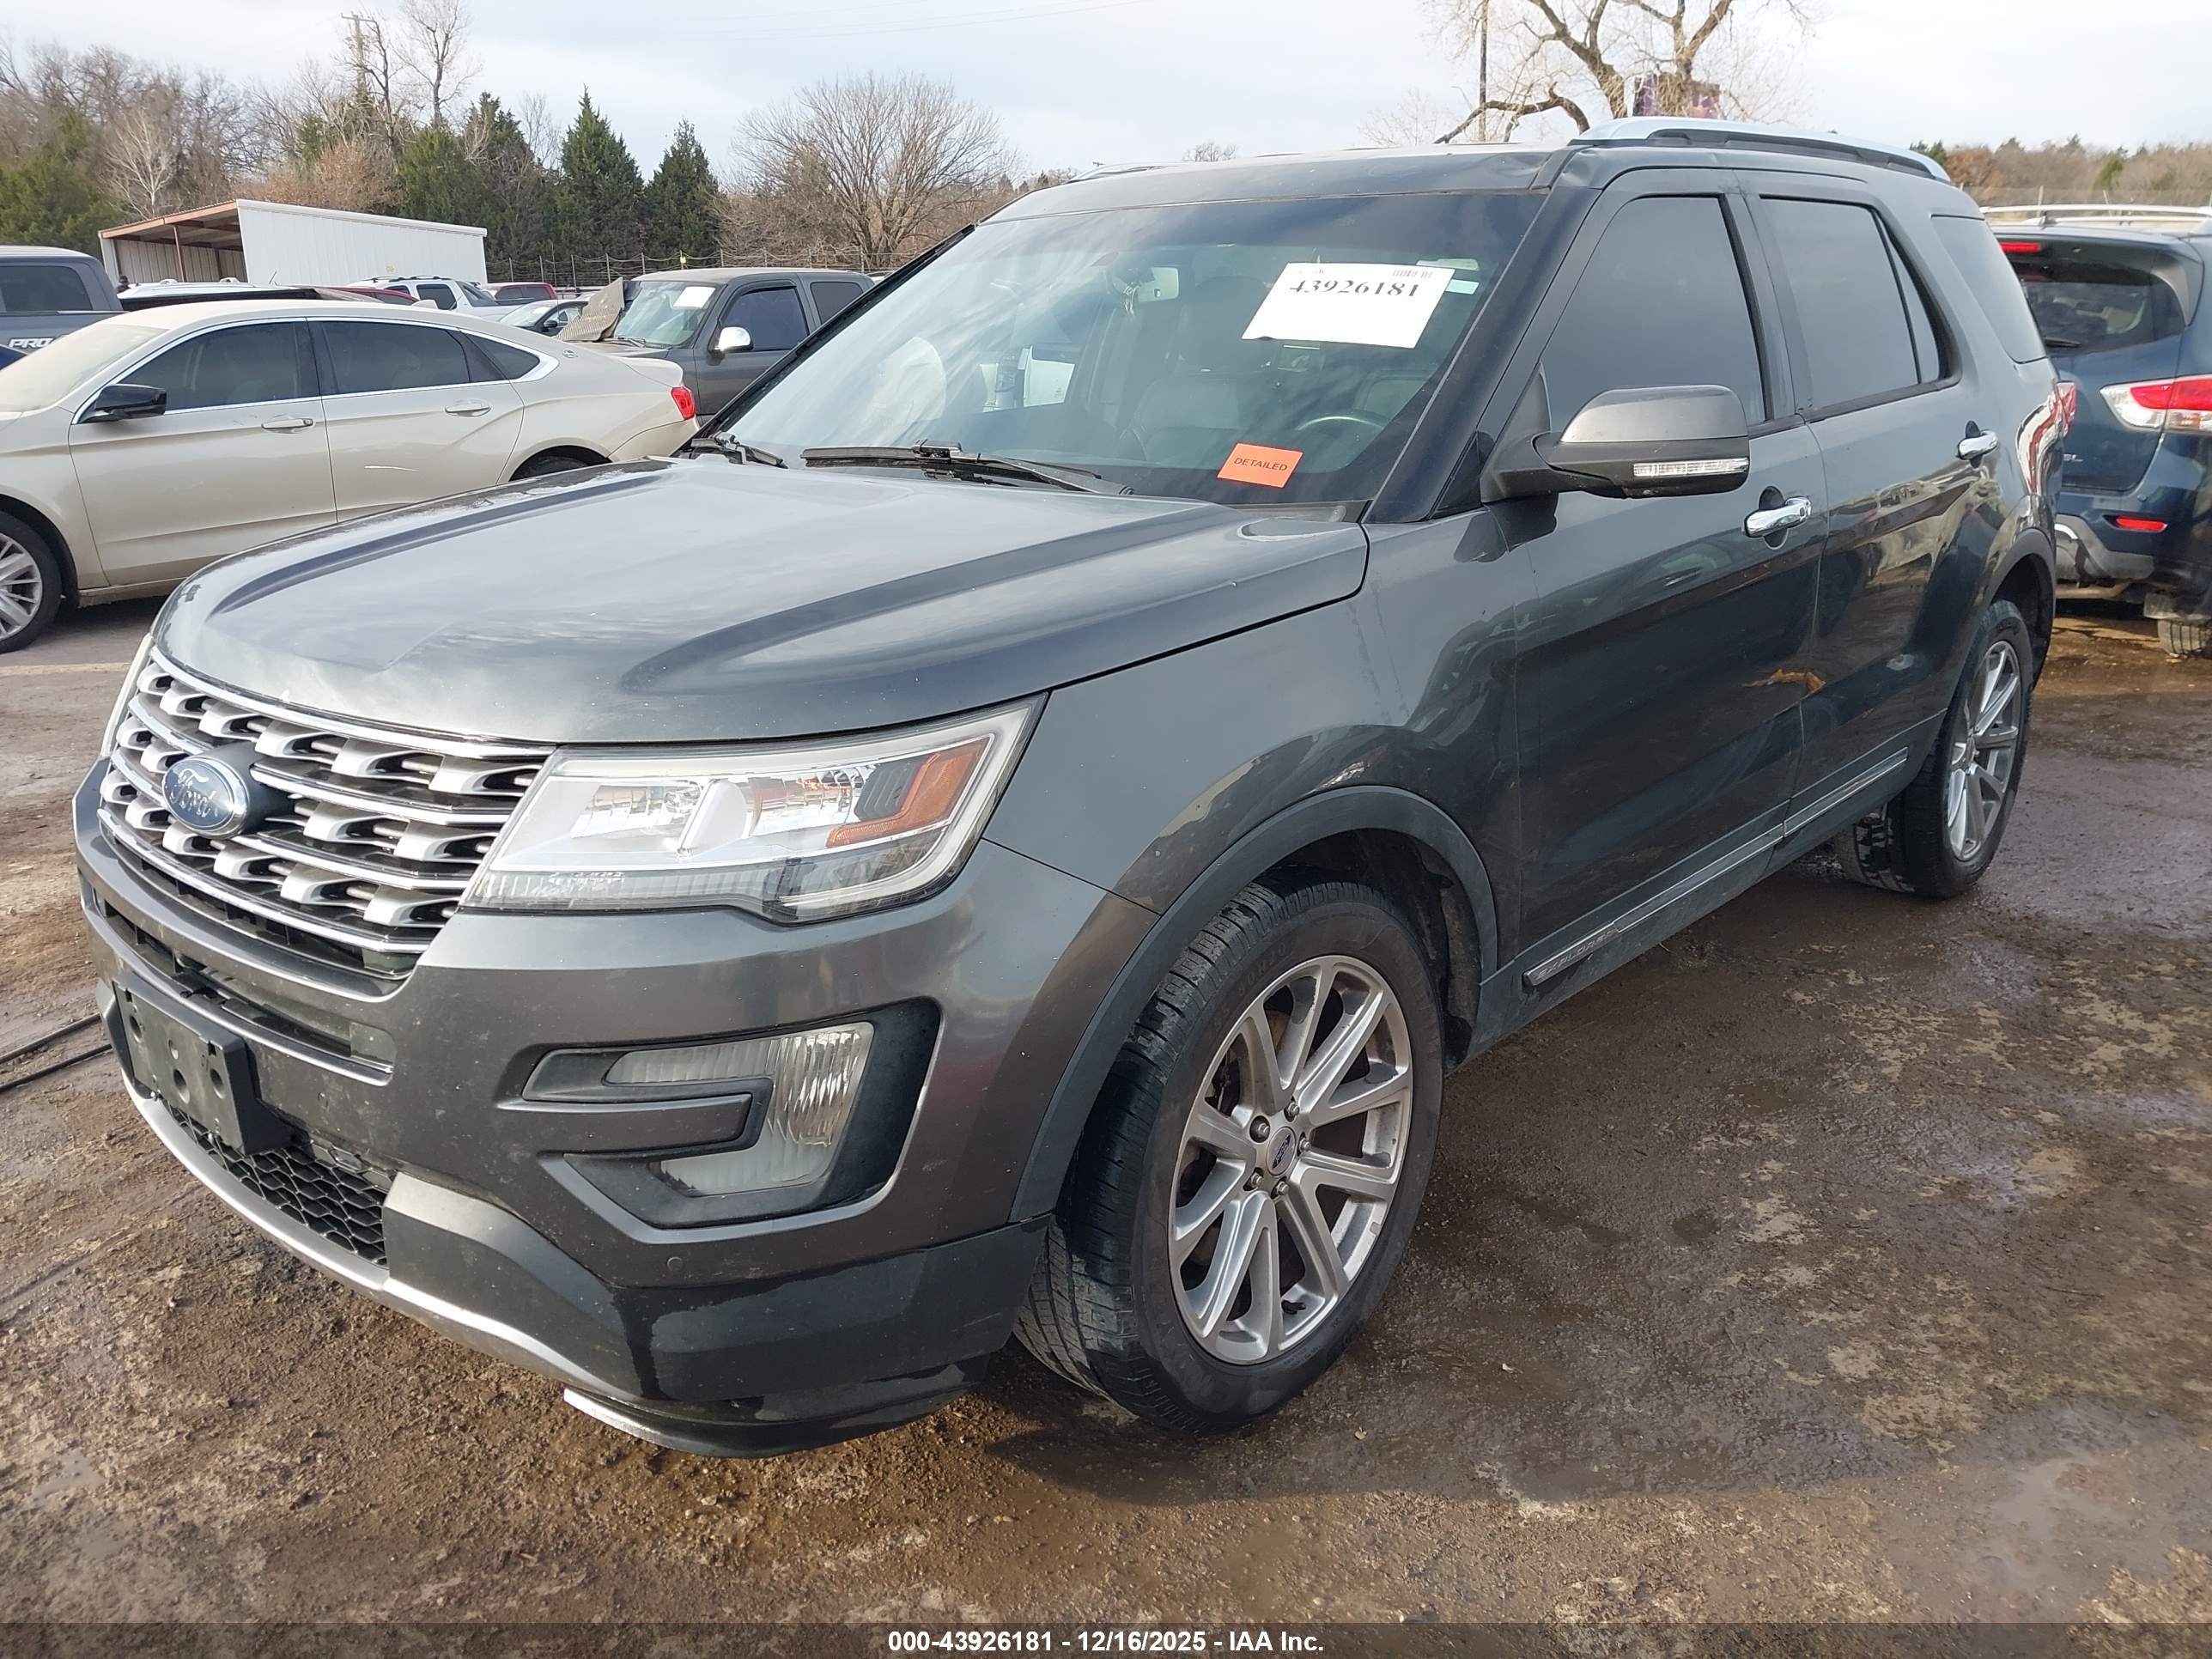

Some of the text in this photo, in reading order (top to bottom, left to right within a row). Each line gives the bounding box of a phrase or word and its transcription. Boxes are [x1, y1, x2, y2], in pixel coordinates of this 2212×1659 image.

[1289, 279, 1420, 297] 43926181
[1233, 457, 1288, 471] DETAILED
[169, 768, 218, 818] Ford
